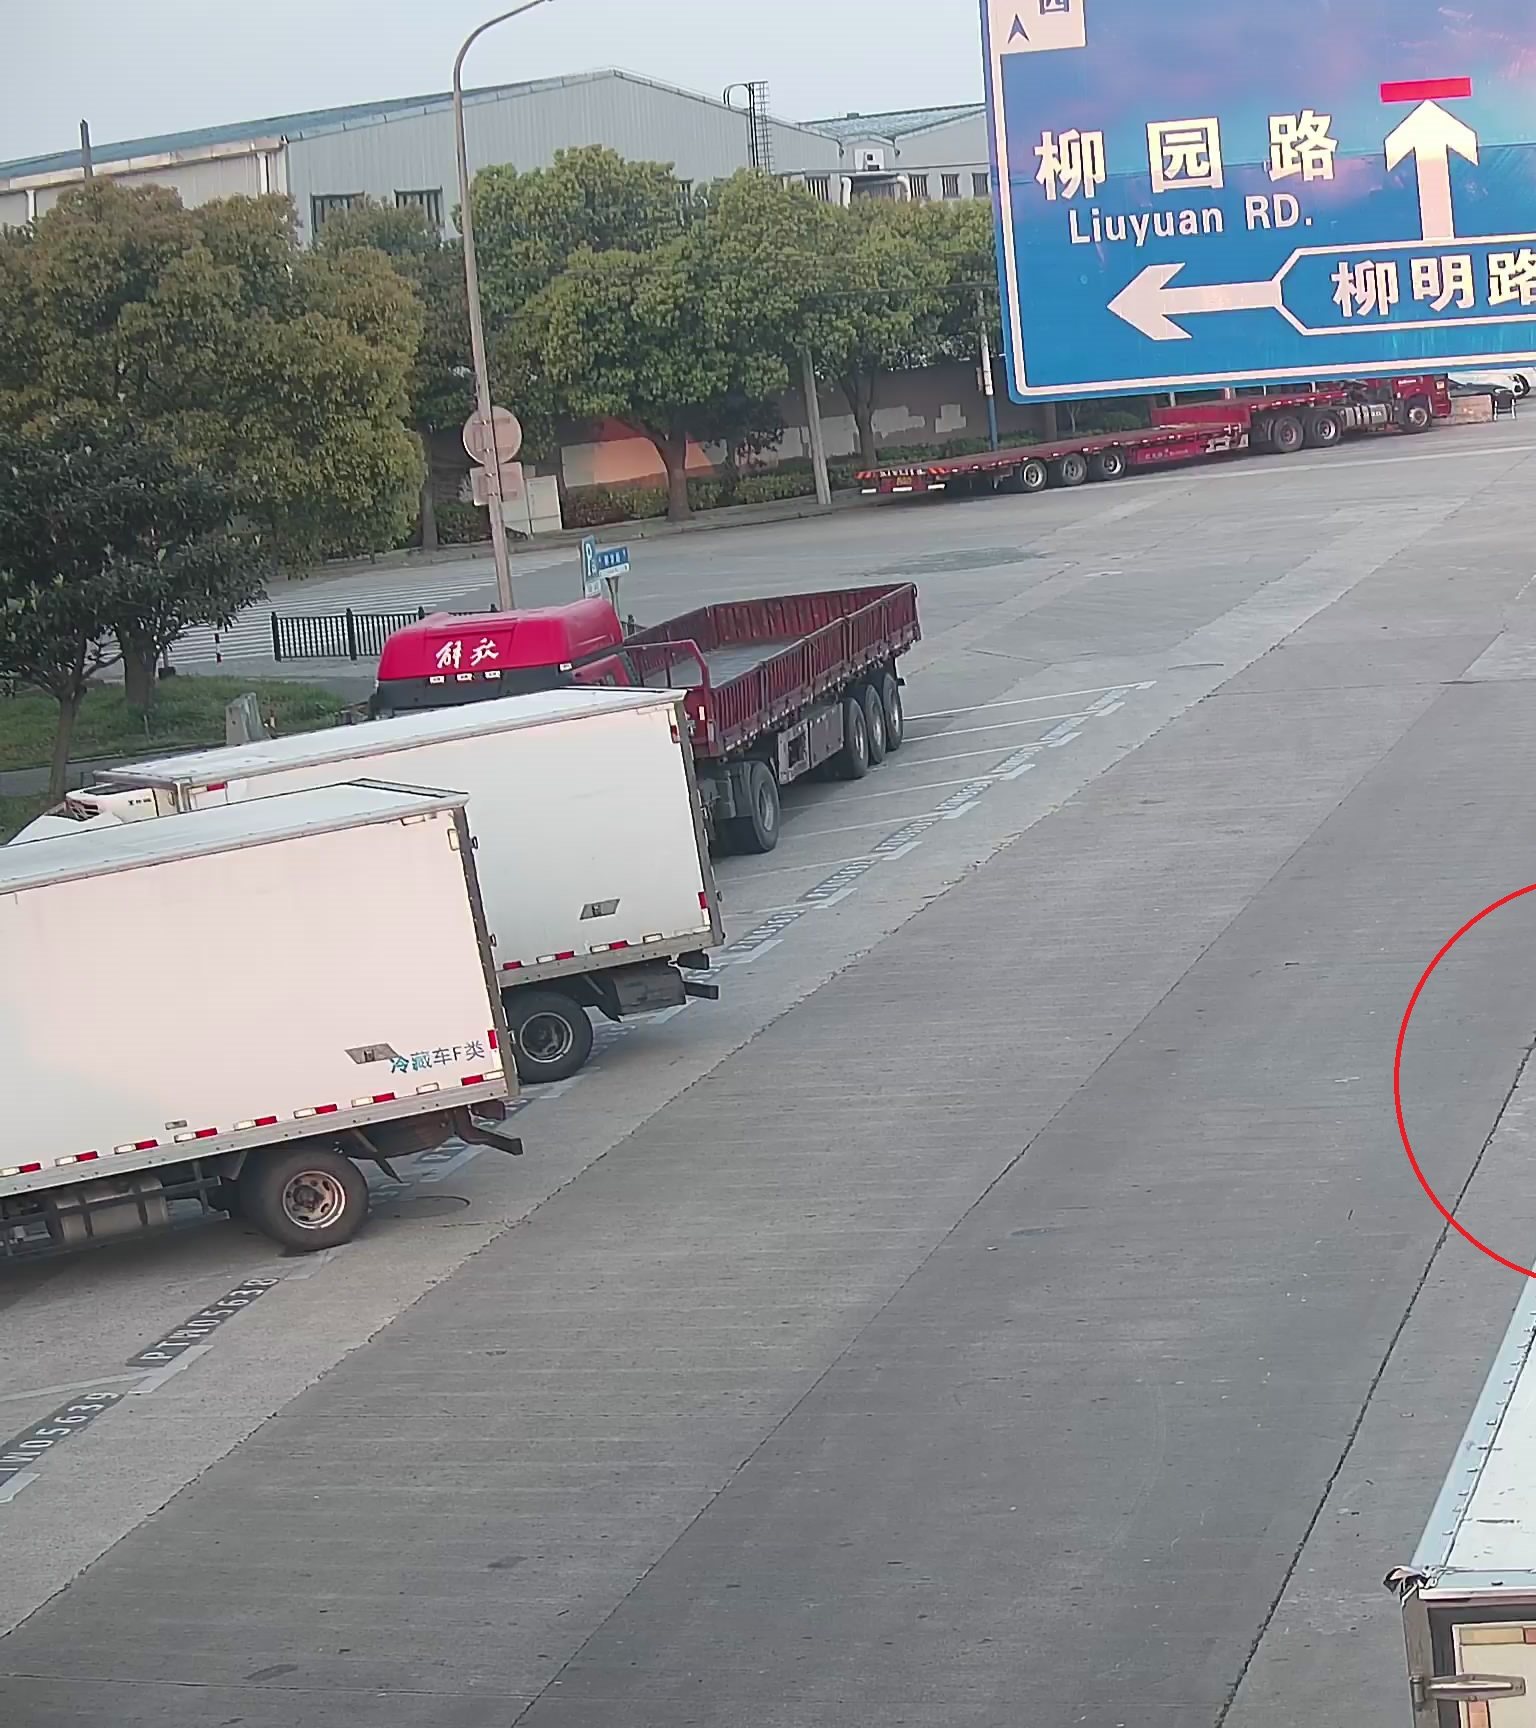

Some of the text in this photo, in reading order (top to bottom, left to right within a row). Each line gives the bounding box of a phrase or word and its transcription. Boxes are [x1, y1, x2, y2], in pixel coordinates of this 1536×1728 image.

[1034, 109, 1338, 202] 柳园路
[1069, 193, 1313, 248] Liuyuan RD.
[391, 1040, 485, 1073] 冷藏车F类
